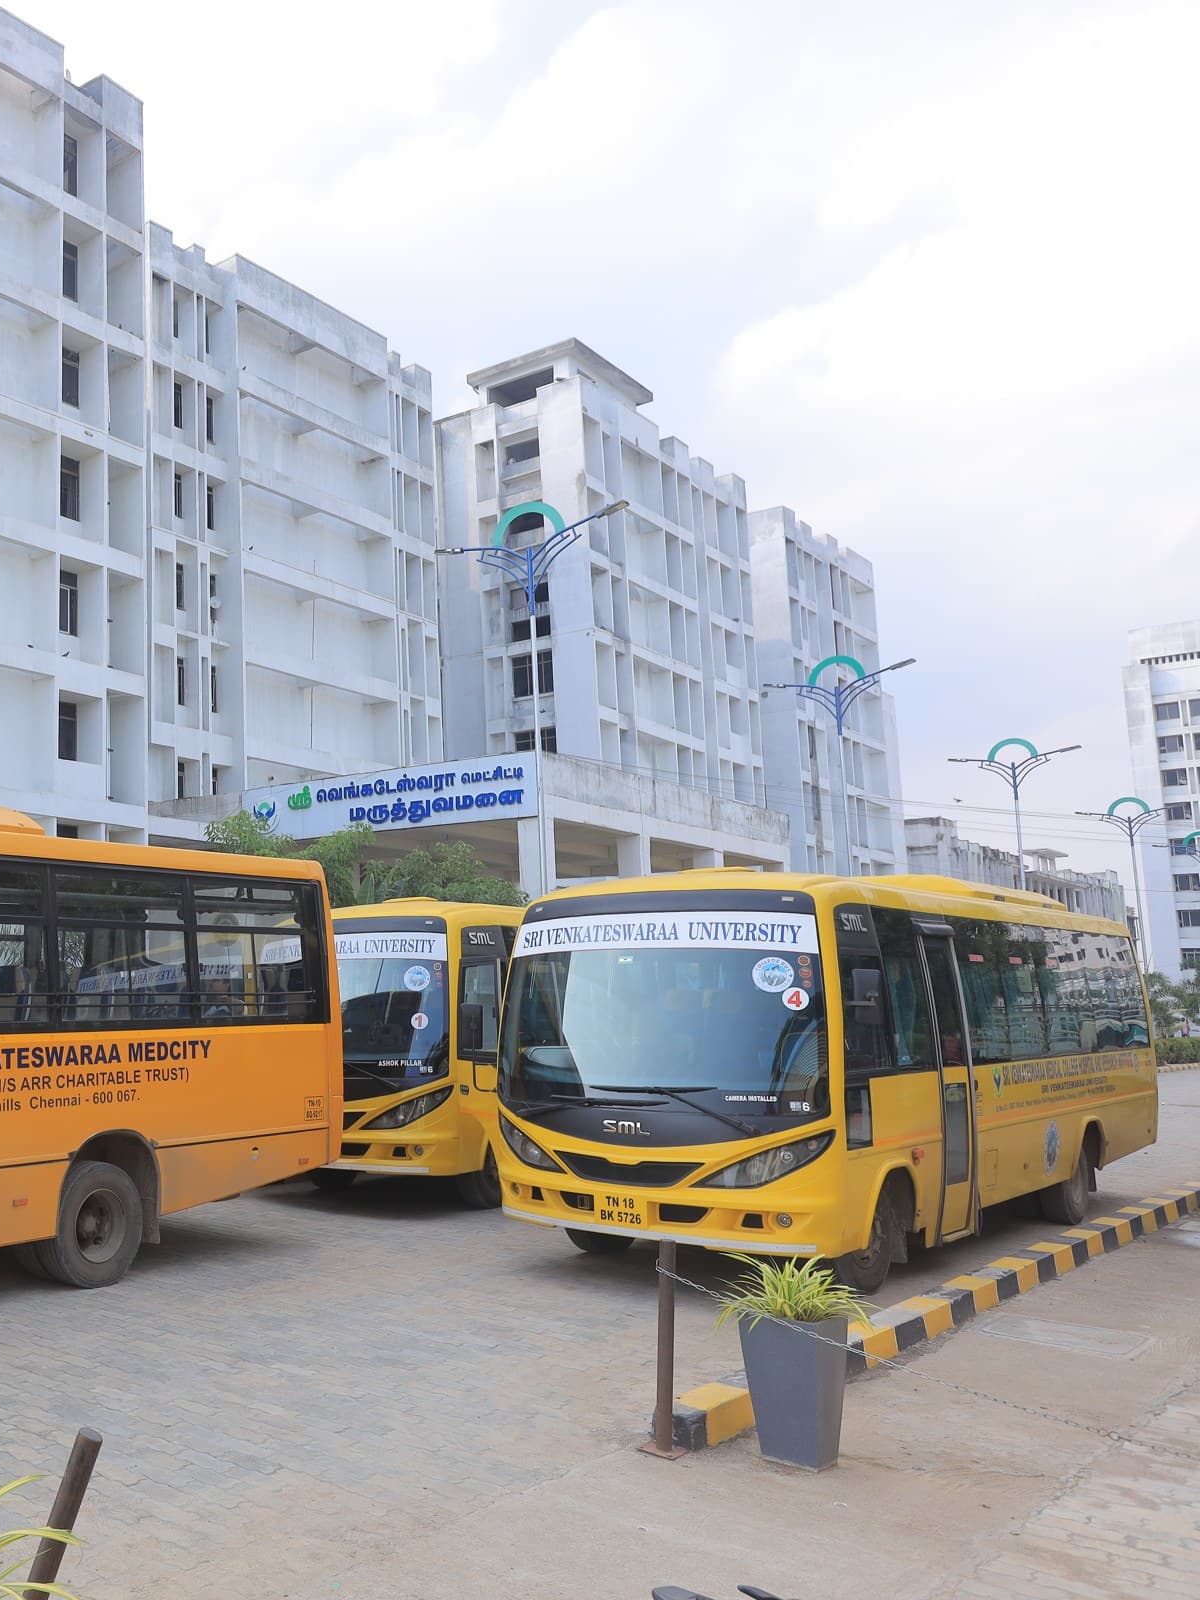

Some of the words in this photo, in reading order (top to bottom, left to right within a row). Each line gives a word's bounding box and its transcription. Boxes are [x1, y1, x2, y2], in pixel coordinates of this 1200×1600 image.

[316, 773, 456, 803] வெங்கடேஸ்வரா
[461, 765, 524, 785] மெட்சிட்டி
[349, 789, 524, 824] மருத்துவமனை
[840, 913, 868, 932] SML
[469, 931, 496, 945] SML
[523, 930, 544, 948] SRI
[546, 922, 679, 946] VENKATESWARAA
[688, 921, 802, 944] UNIVERSITY
[365, 939, 436, 954] UNIVERSITY
[787, 990, 803, 1008] 4
[414, 1015, 424, 1028] 1
[128, 1040, 211, 1062] MEDCITY
[20, 1076, 51, 1091] ARR
[56, 1070, 141, 1088] CHARITABLE
[145, 1067, 190, 1083] TRUST)
[29, 1093, 81, 1109] Chennai
[93, 1091, 113, 1104] 600
[802, 1102, 810, 1111] 6
[602, 1119, 651, 1136] SML
[606, 1196, 619, 1207] TN
[622, 1198, 635, 1209] 18
[600, 1210, 614, 1221] BK
[617, 1211, 642, 1224] 5726
